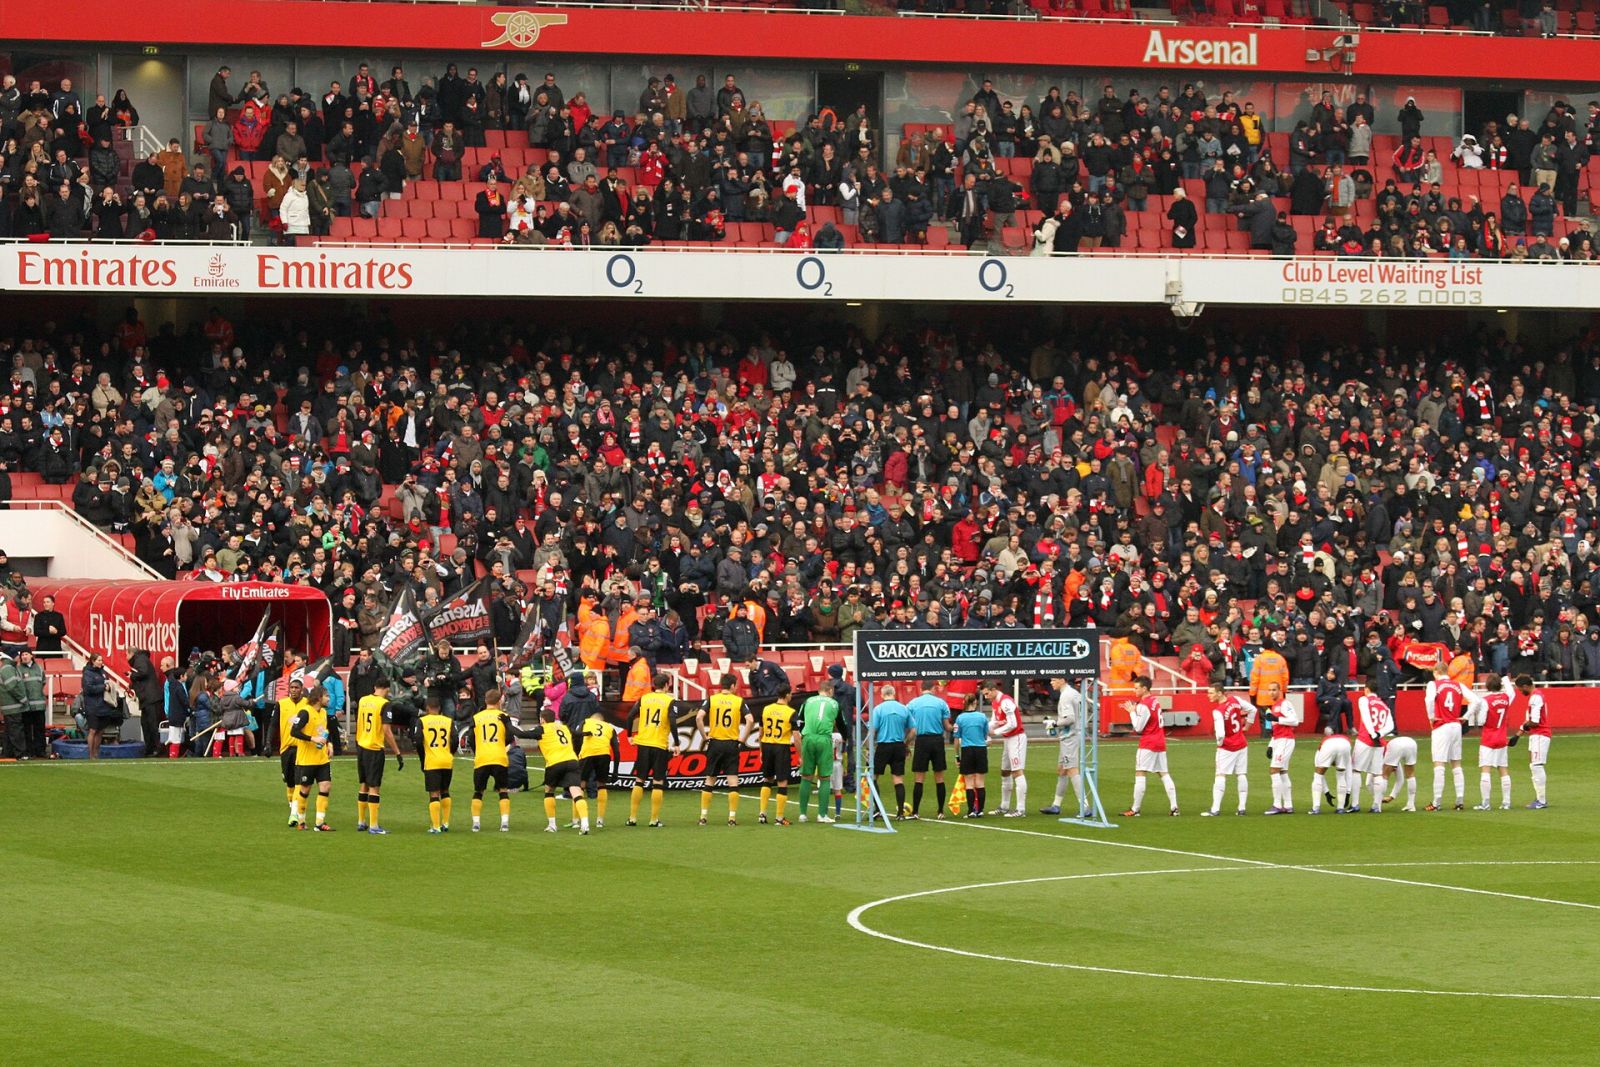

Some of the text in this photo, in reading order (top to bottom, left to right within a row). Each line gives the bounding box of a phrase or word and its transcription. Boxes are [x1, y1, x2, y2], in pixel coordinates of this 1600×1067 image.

[1143, 30, 1258, 66] Arsenal
[17, 250, 177, 287] Emirates
[257, 254, 413, 289] Emirates
[1283, 263, 1483, 289] Club Level Waiting List
[193, 276, 240, 288] Emirates
[1282, 288, 1483, 305] 0845 262 0003
[222, 586, 290, 600] Fly Emirates
[89, 613, 177, 657] Fly Emirates
[878, 642, 1071, 658] BARCLAYS PREMIER LEAGUE
[1444, 691, 1455, 712] 4
[362, 712, 373, 733] 15
[646, 708, 661, 727] 14
[715, 708, 732, 728] 16
[765, 718, 784, 738] 35
[1230, 712, 1241, 734] 5
[1371, 706, 1387, 729] 39
[1497, 708, 1506, 729] 7
[428, 727, 448, 748] 23
[482, 723, 498, 743] 12
[556, 729, 568, 744] 8
